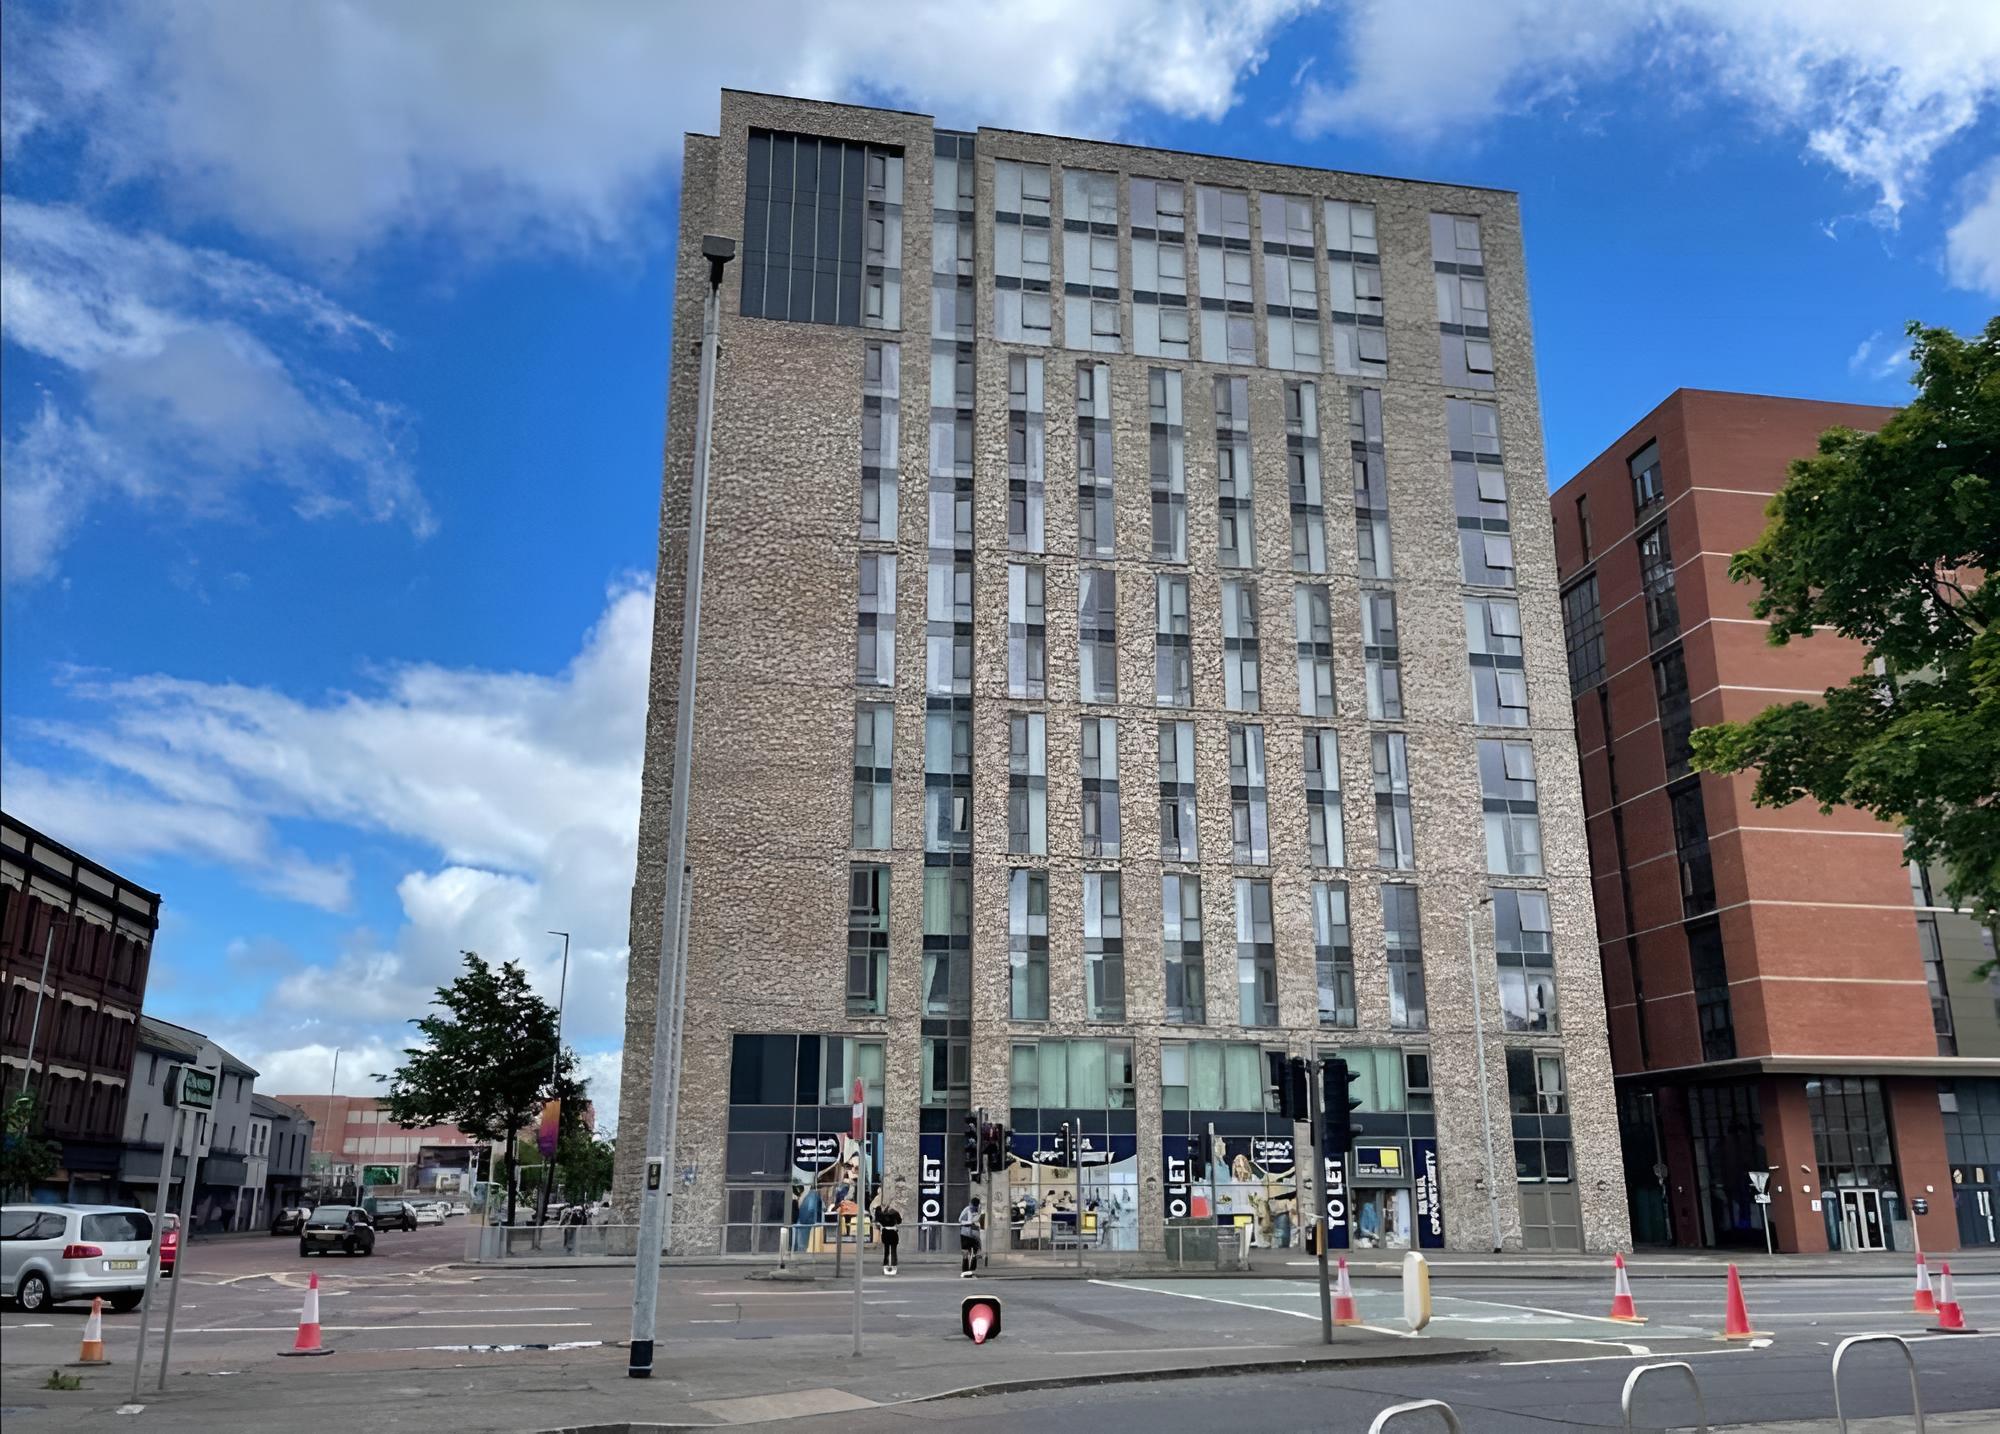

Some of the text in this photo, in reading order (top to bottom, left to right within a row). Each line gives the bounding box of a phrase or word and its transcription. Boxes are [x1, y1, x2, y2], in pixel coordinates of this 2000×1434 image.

[921, 1154, 940, 1230] TO LET
[1168, 1156, 1186, 1195] LET
[1324, 1157, 1346, 1230] TO LET
